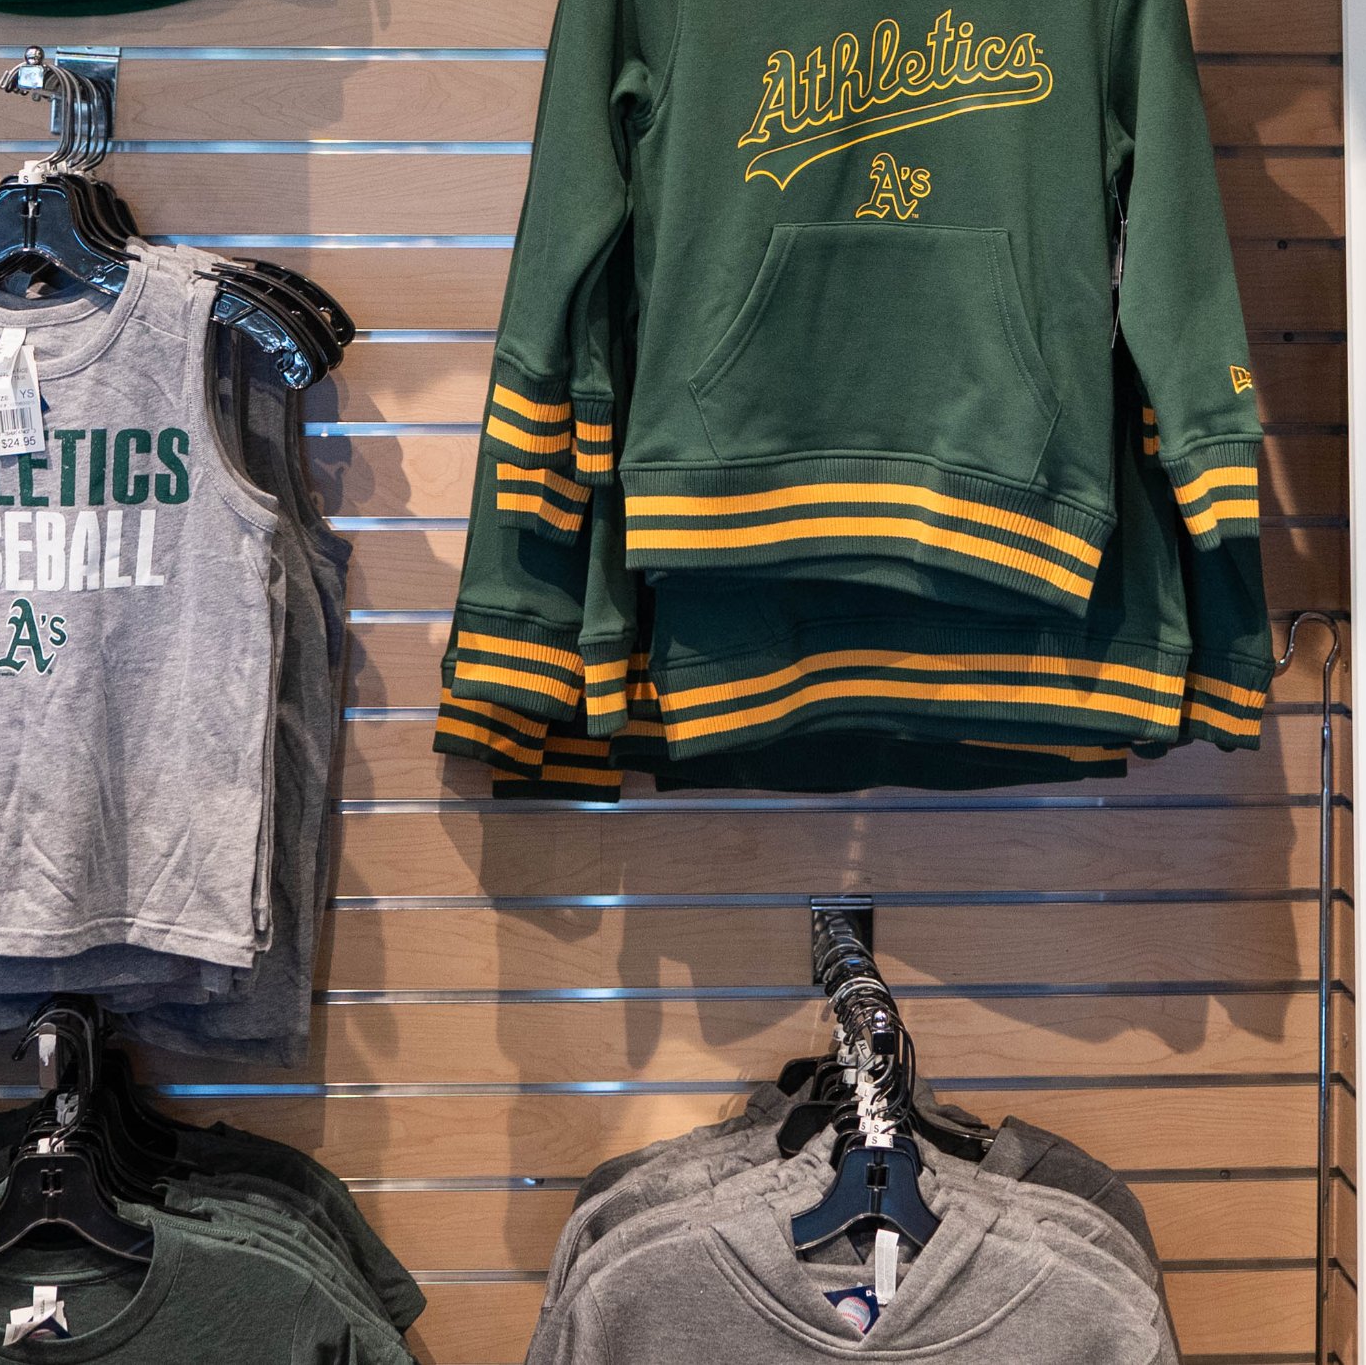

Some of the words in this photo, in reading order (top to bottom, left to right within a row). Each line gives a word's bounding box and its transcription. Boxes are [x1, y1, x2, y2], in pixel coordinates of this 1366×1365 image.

[738, 8, 1054, 148] Athletics
[855, 152, 932, 220] A's
[19, 389, 35, 399] YS
[871, 1135, 878, 1145] S
